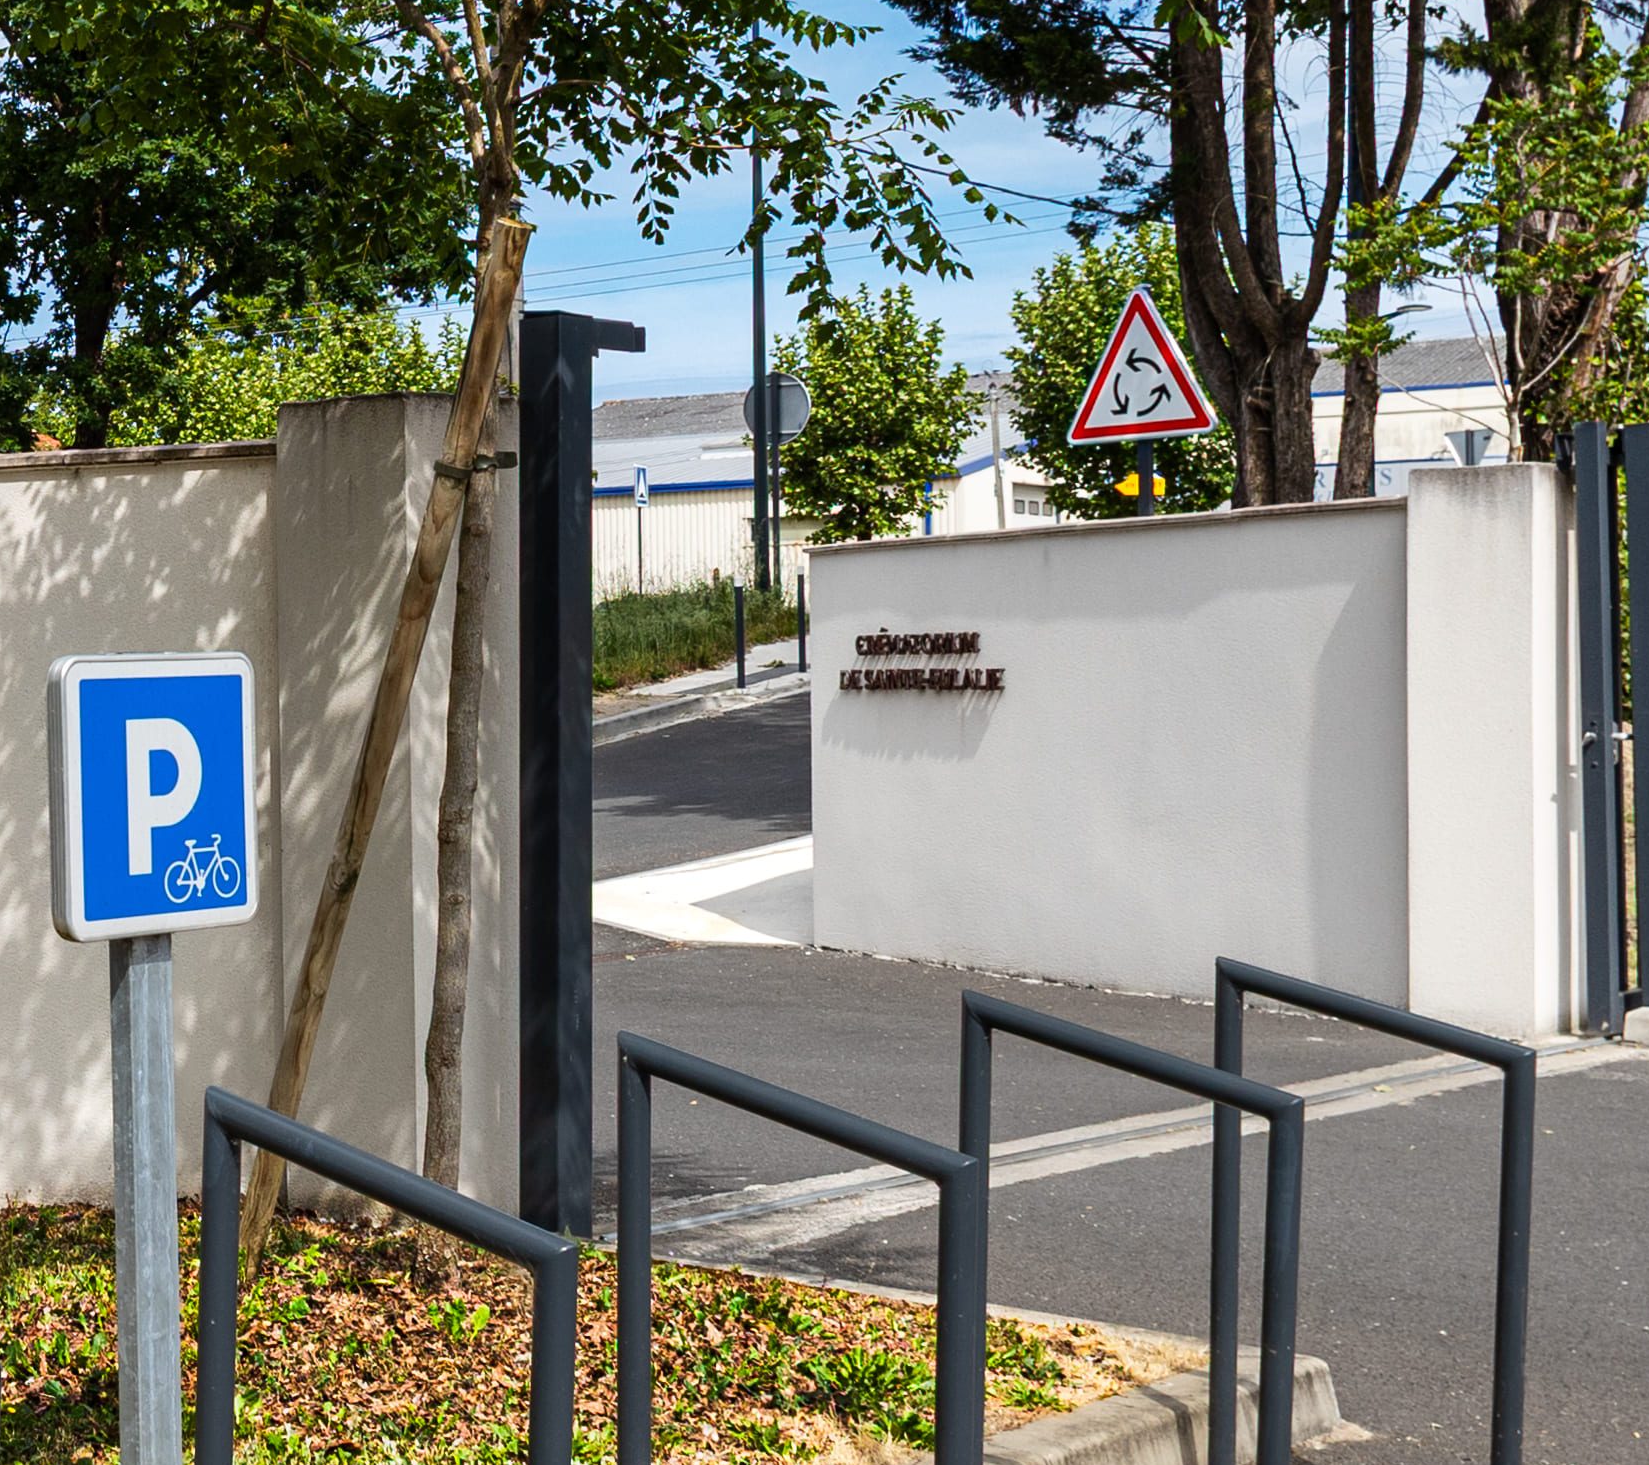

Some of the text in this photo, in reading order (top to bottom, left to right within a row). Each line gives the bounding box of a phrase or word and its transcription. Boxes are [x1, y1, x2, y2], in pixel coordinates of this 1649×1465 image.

[855, 627, 980, 655] CRÉMATORIUM
[839, 669, 863, 690] DE
[125, 717, 203, 876] P
